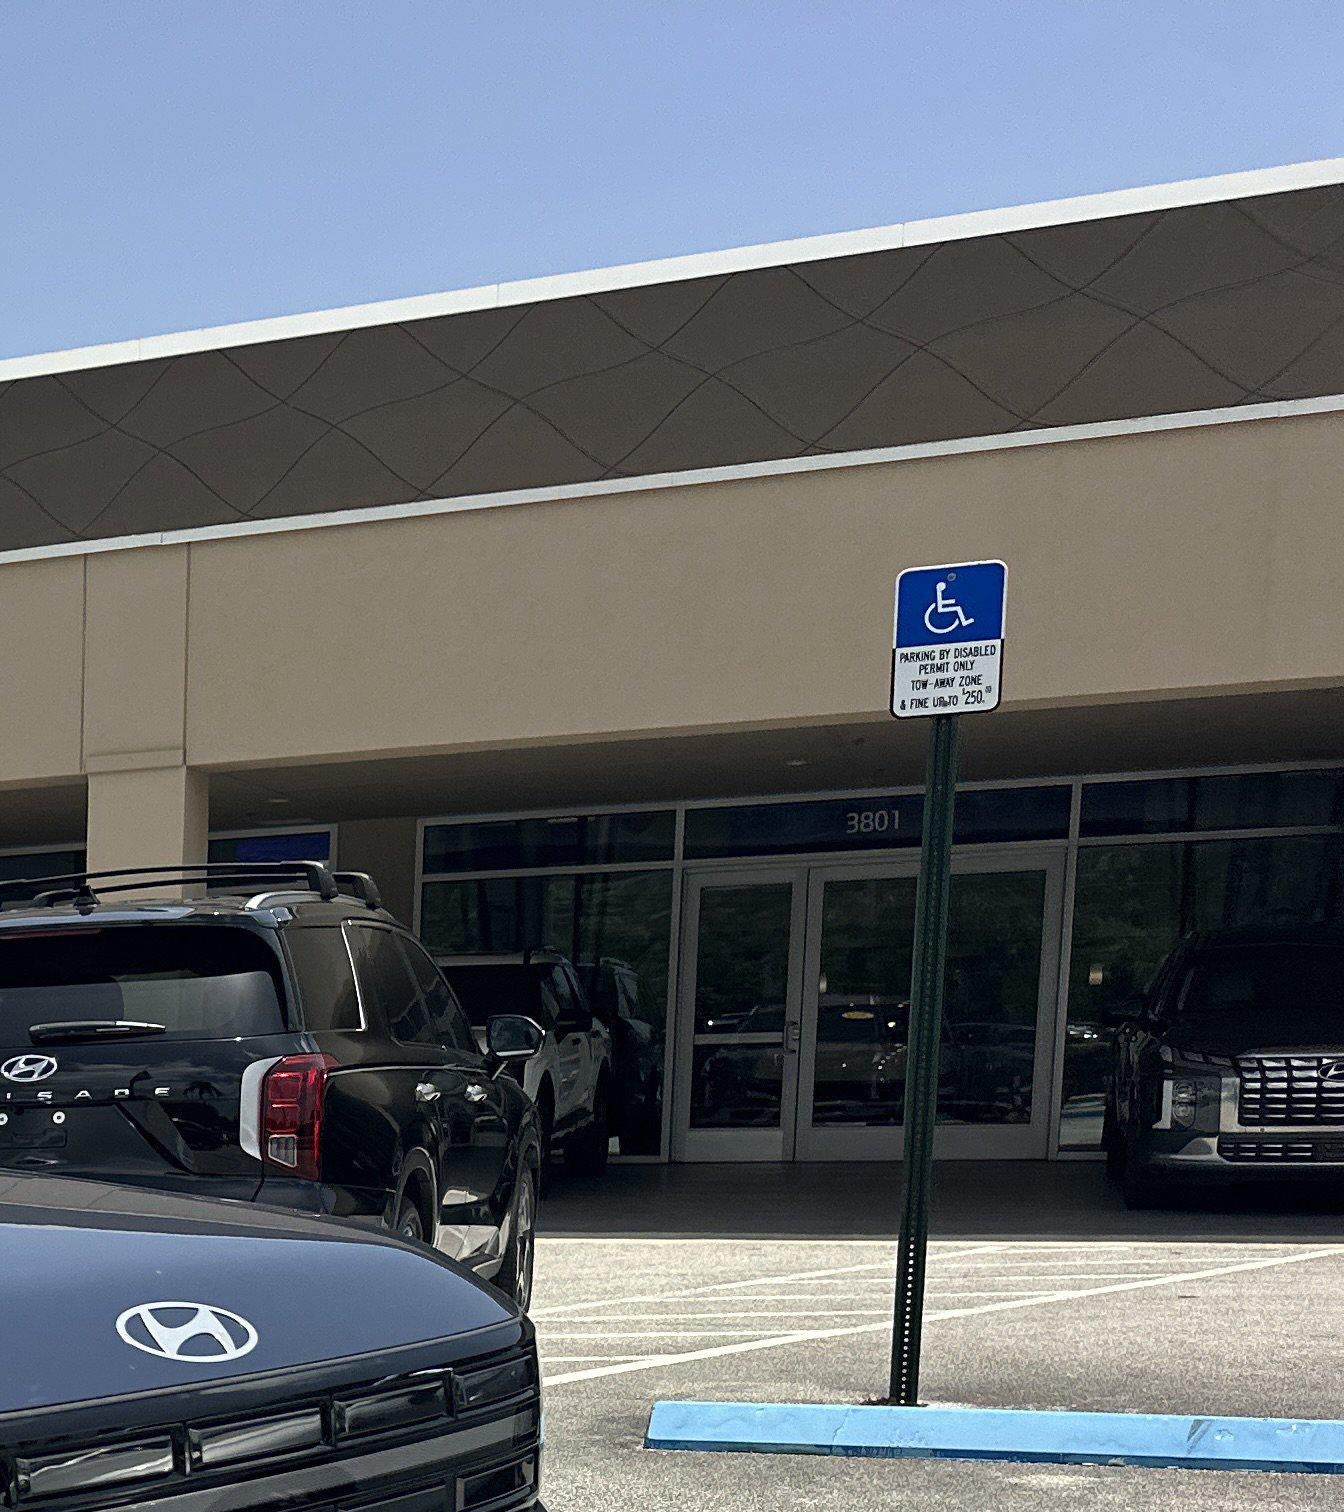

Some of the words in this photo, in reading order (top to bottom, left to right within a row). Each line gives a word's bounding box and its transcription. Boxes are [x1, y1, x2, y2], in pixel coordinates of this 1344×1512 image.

[899, 650, 936, 664] PARKING
[939, 648, 951, 661] BY
[954, 645, 996, 659] DISABLED
[919, 662, 950, 675] PERMIT
[953, 659, 976, 673] ONLY
[911, 677, 956, 691] TOW-AWAY
[959, 674, 983, 687] ZONE
[899, 699, 907, 711] &
[909, 696, 930, 710] FINE
[846, 810, 900, 834] 3801
